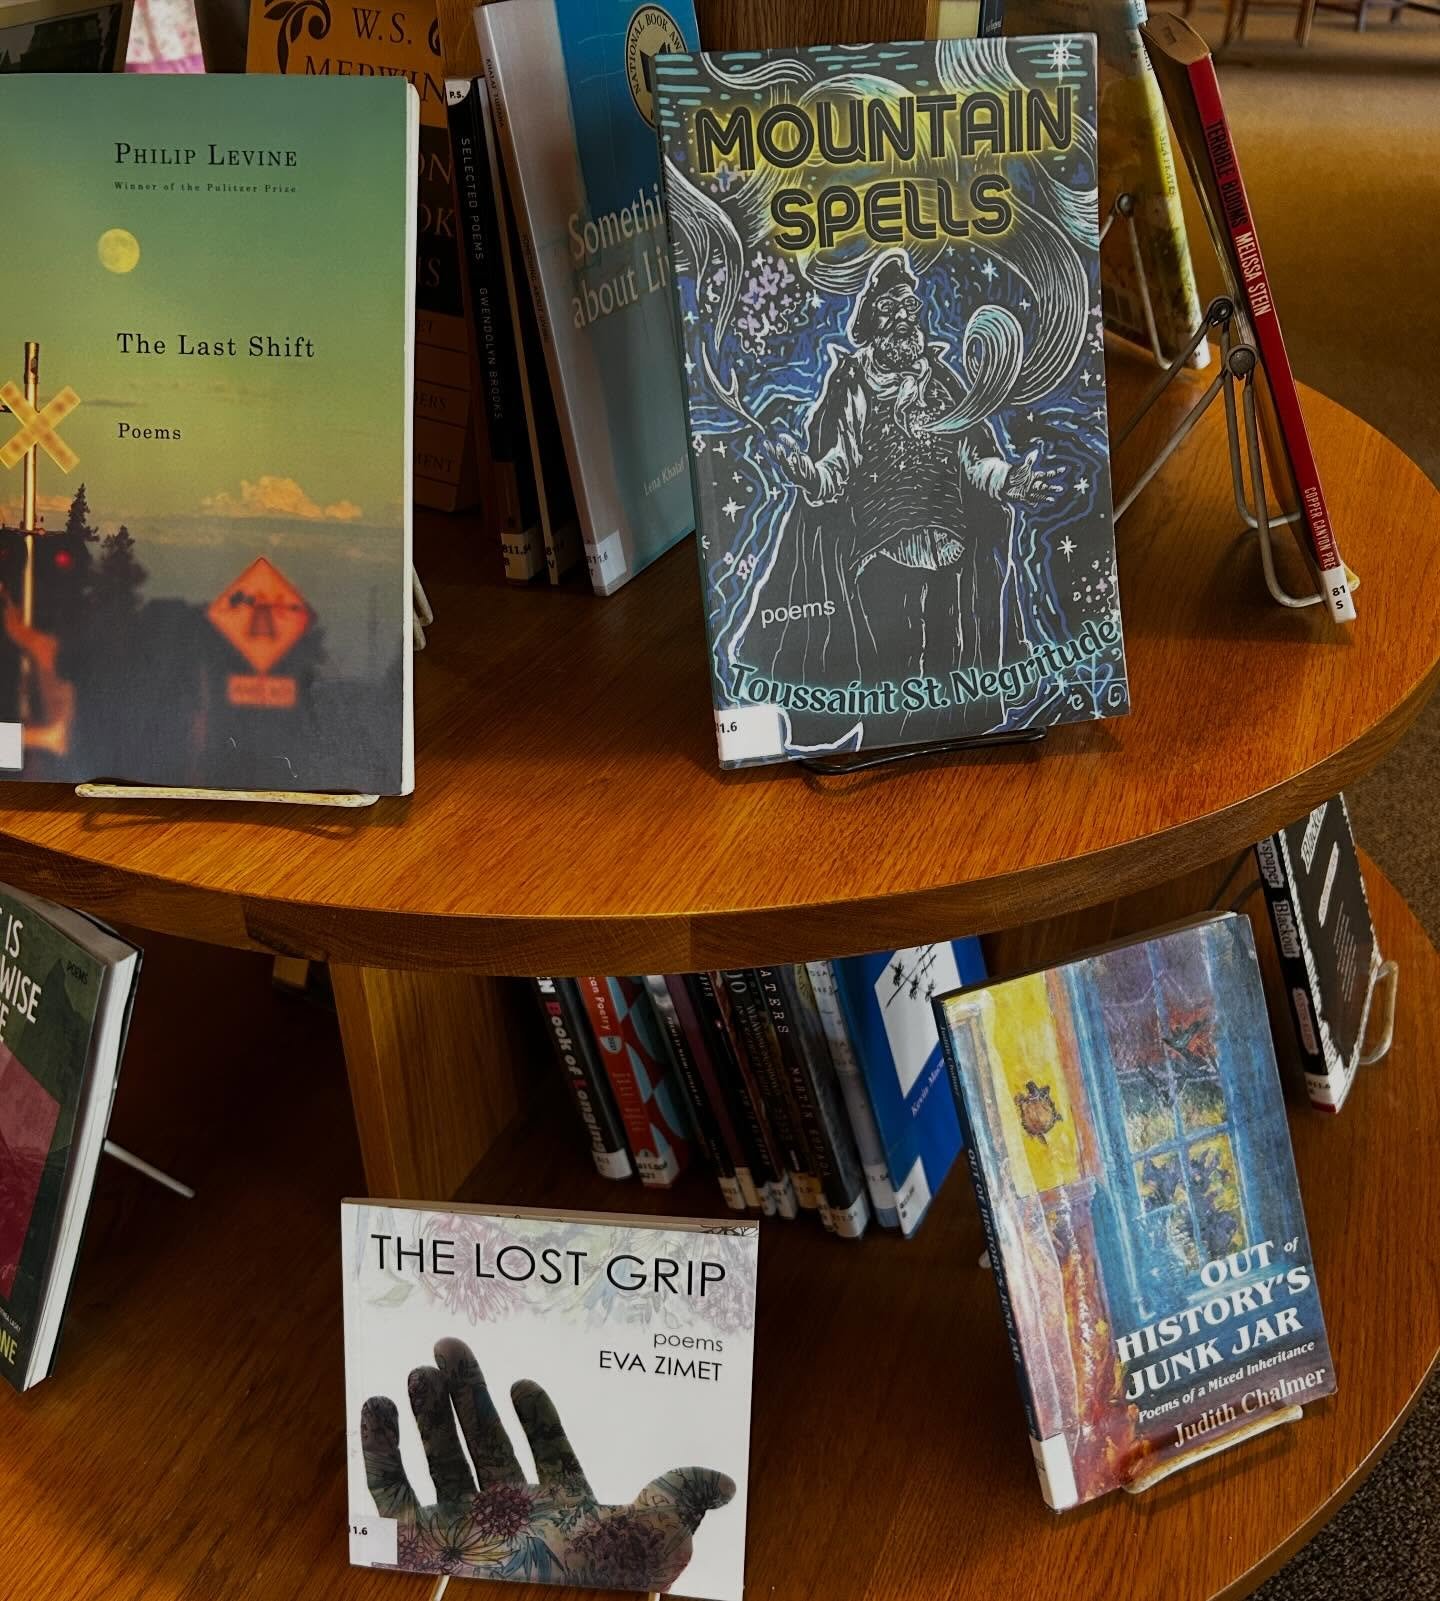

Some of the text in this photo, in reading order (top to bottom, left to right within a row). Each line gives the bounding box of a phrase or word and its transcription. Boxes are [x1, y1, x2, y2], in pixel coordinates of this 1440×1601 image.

[629, 14, 682, 95] NATIONAL BOOK AW
[114, 142, 297, 167] PHILIP LEVINE
[695, 87, 1073, 174] MOUNTAIN
[1206, 119, 1235, 178] TERRIBLE
[114, 181, 297, 193] Winner of the Pulitzer Prize
[771, 174, 1013, 250] SPELLS
[568, 183, 664, 260] Somethi
[461, 137, 478, 209] SELECTED
[470, 215, 484, 260] POEMS
[479, 288, 496, 366] GWENDOLYN
[1235, 231, 1263, 281] MELISSA
[572, 267, 639, 328] about
[1248, 282, 1272, 317] STEIN
[117, 333, 315, 358] The Last Shift
[118, 423, 182, 440] Poems
[1304, 486, 1336, 569] COPPER CANYON PRE
[760, 600, 836, 629] poems
[1335, 600, 1344, 610] S
[902, 677, 949, 713] St.
[1261, 838, 1297, 957] spaper Blackout
[5, 914, 24, 959] IS
[545, 1000, 573, 1050] Book
[564, 1053, 584, 1076] of
[968, 1148, 982, 1181] OUT
[370, 1233, 727, 1297] THE LOST GRIP
[1200, 1236, 1299, 1288] OUT of
[653, 1332, 724, 1353] poems
[1115, 1265, 1311, 1363] HISTORY'S
[600, 1350, 723, 1382] EVA ZIMET
[1125, 1307, 1304, 1400] JUNK JAR
[1138, 1340, 1315, 1424] Poems of a Mixed Inheritance
[1174, 1368, 1326, 1448] Judith Chalmer
